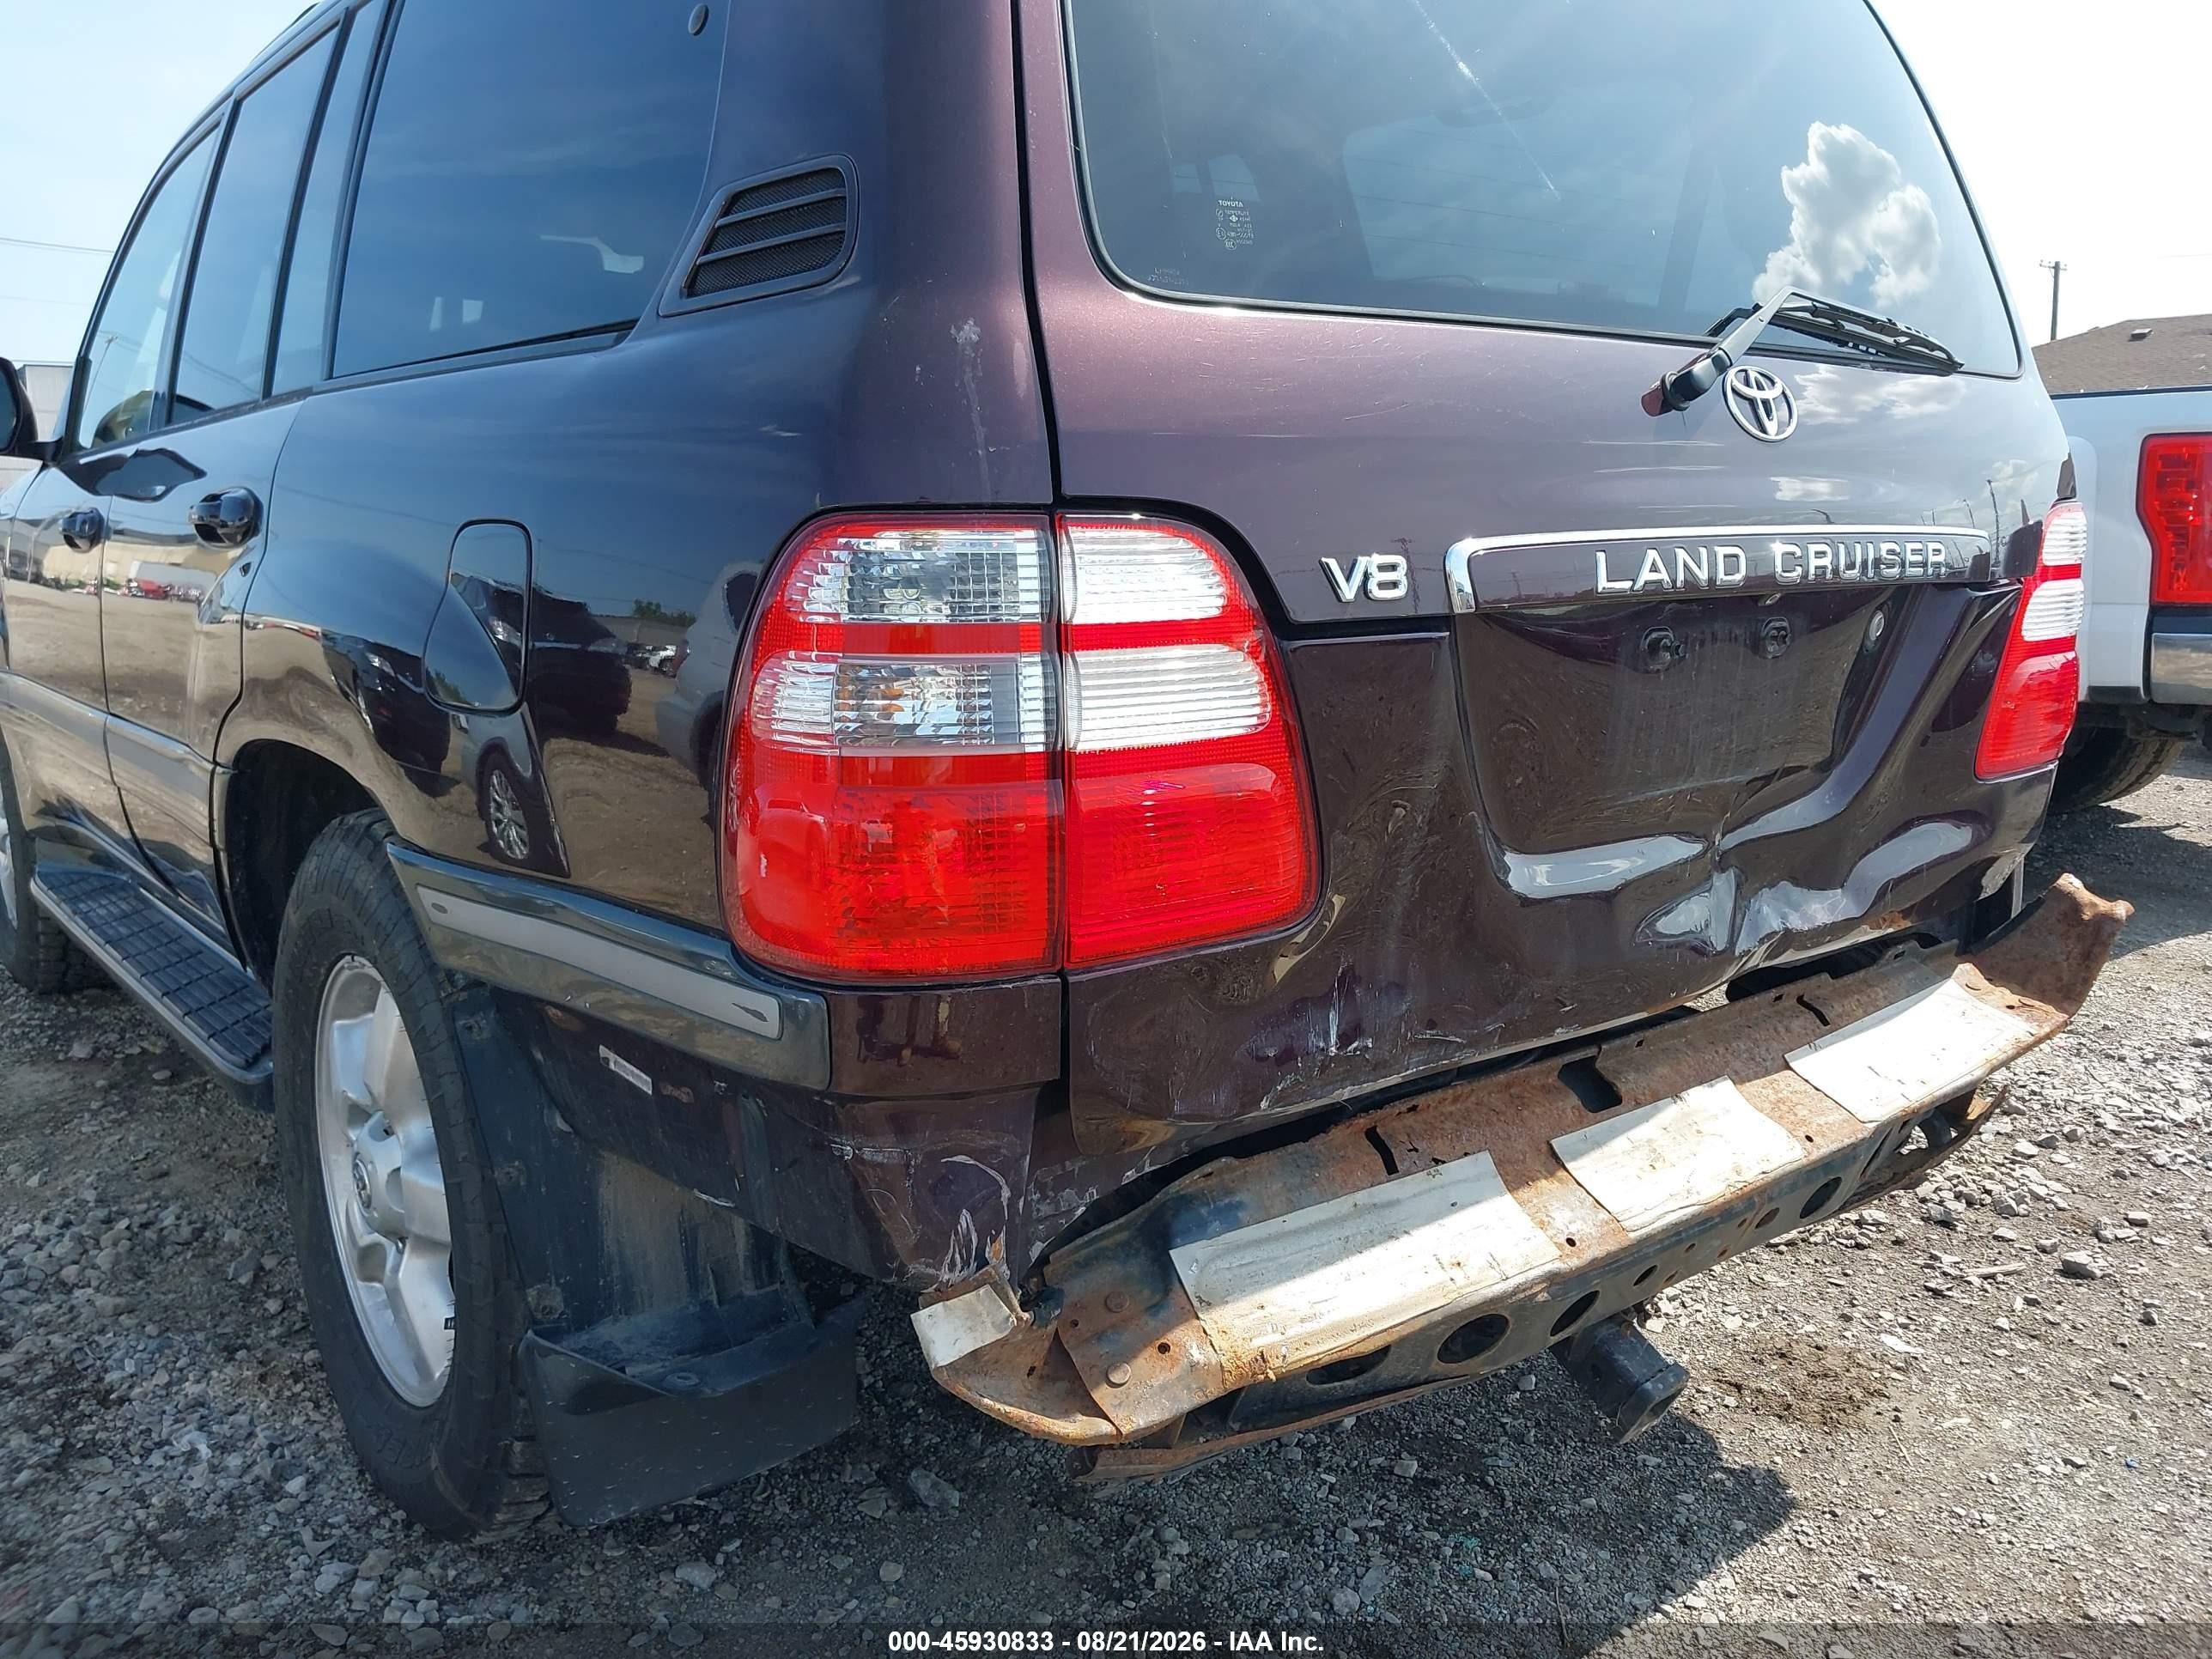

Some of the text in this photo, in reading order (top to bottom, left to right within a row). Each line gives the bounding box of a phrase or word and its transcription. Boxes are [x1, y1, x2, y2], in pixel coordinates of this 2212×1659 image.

[1319, 554, 1408, 602] V8
[1595, 541, 1948, 595] LAND CRUISER
